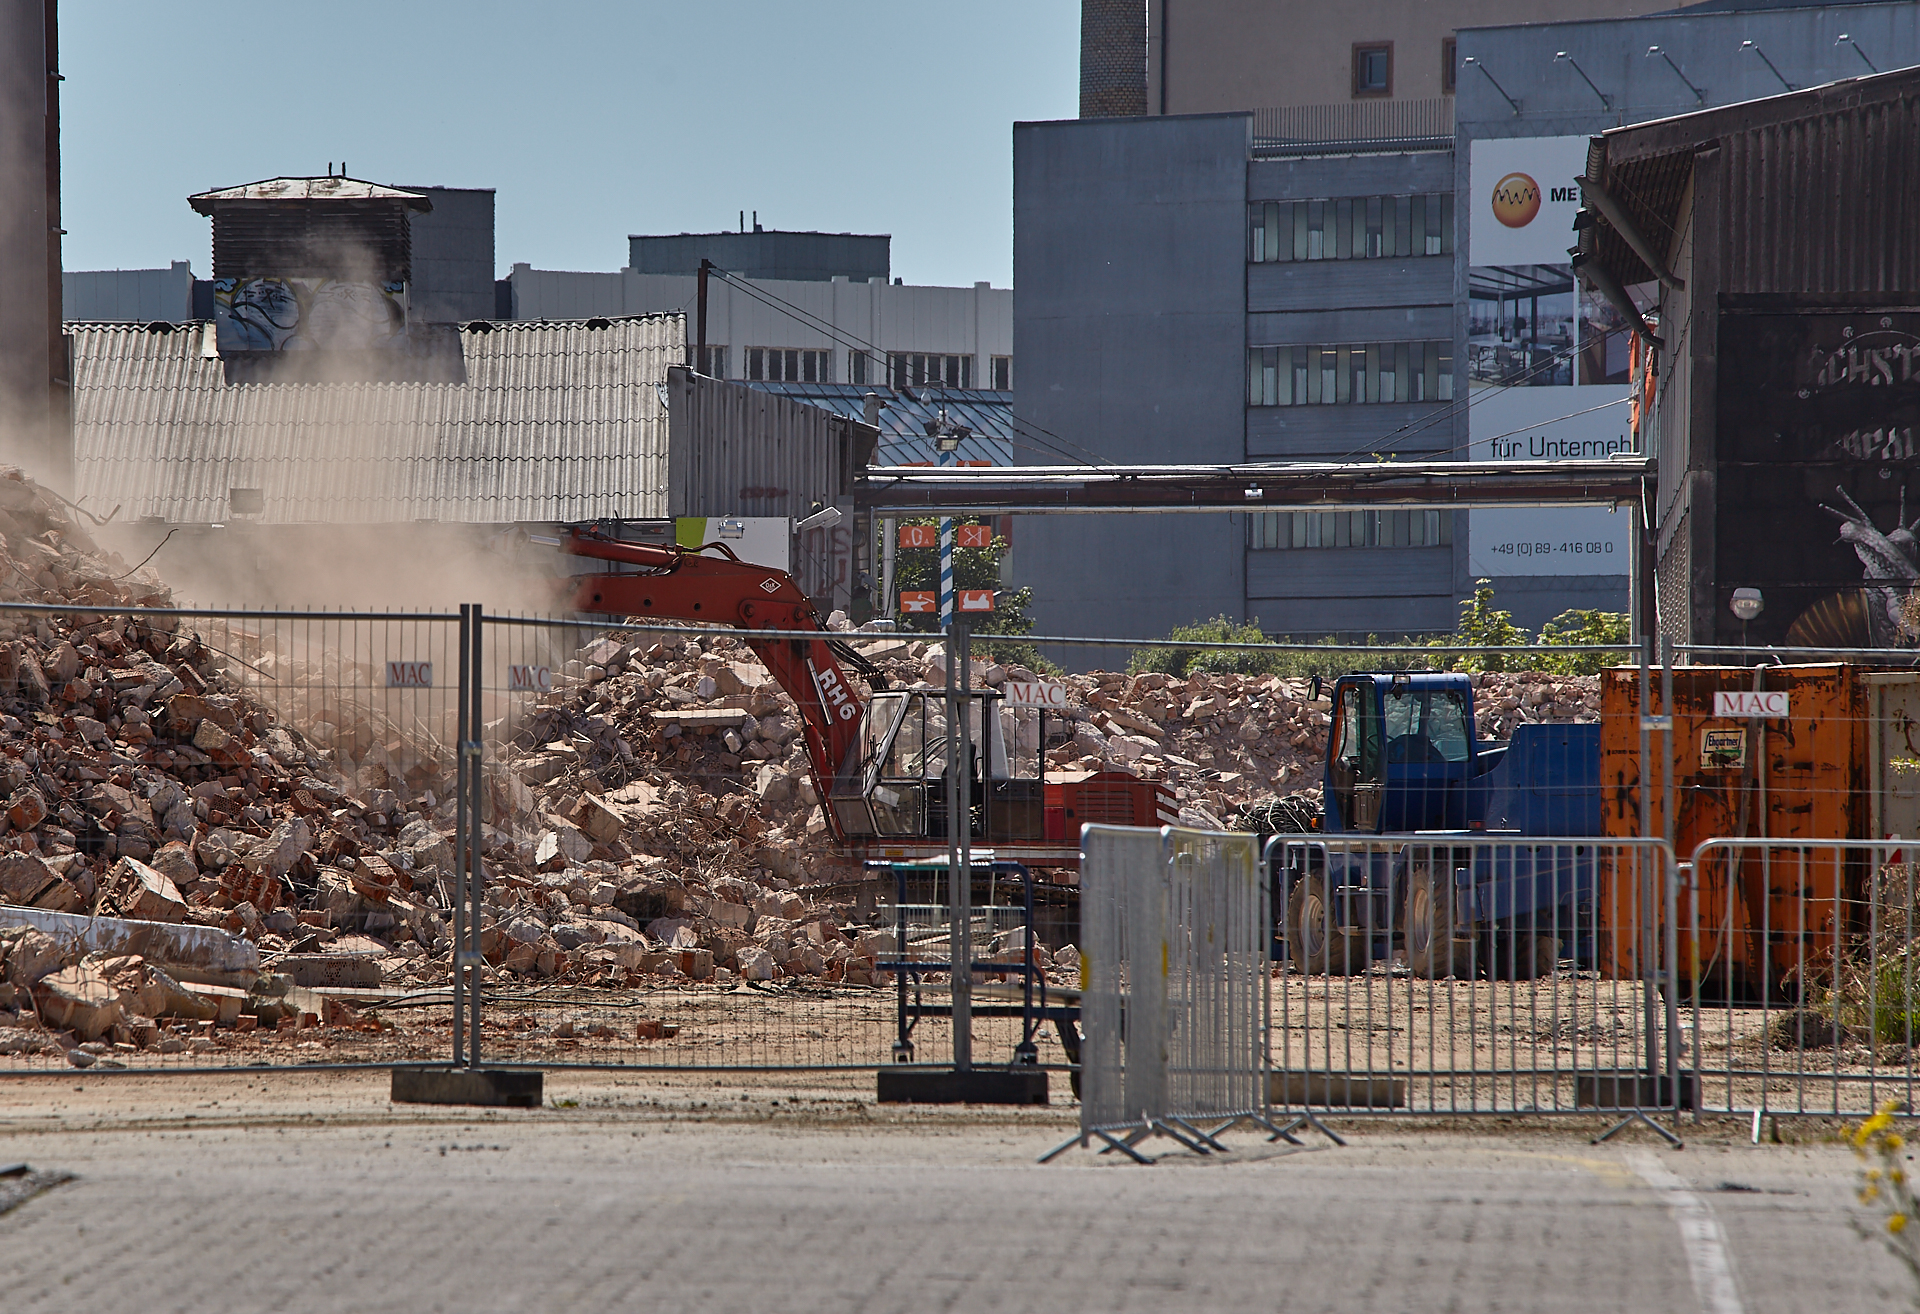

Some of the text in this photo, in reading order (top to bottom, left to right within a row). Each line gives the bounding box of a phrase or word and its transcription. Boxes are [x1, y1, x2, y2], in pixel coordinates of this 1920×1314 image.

[1551, 187, 1580, 202] ME
[1491, 437, 1522, 458] für
[1491, 543, 1514, 554] +49
[1517, 543, 1532, 556] (0)
[1535, 543, 1550, 554] 89
[1559, 542, 1583, 553] 416
[1586, 542, 1602, 553] 08
[1605, 541, 1614, 553] 0
[391, 663, 430, 684] MAC
[1012, 683, 1063, 704] MAC
[1722, 693, 1784, 713] MAC
